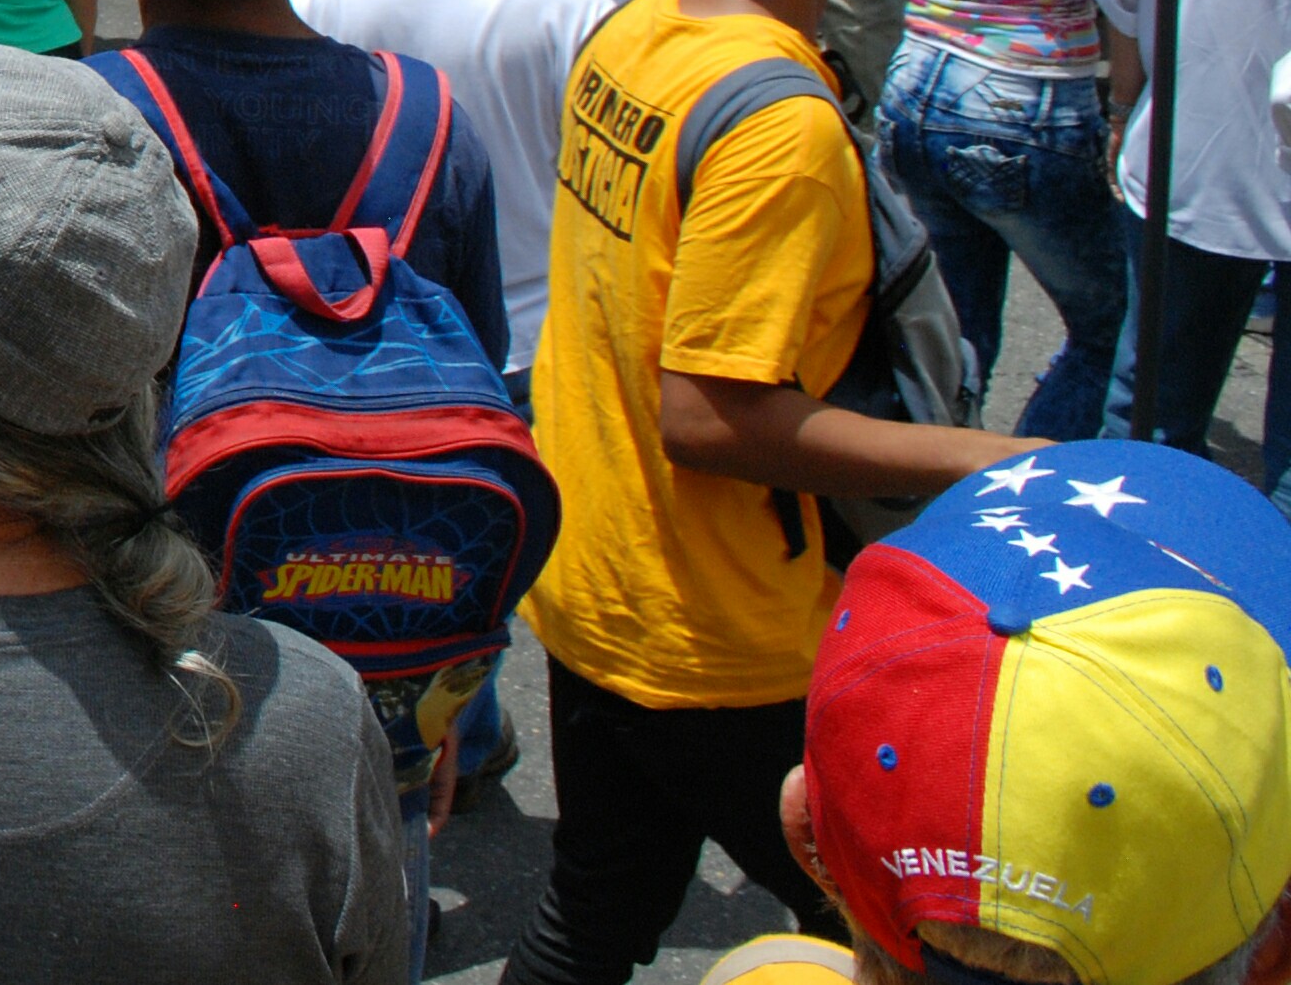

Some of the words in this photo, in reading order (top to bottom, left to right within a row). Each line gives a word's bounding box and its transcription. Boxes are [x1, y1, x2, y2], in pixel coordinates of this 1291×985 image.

[286, 552, 452, 564] ULTIMATE
[263, 563, 452, 601] SPIDER-MAN
[881, 847, 1094, 924] VENEZUELA
